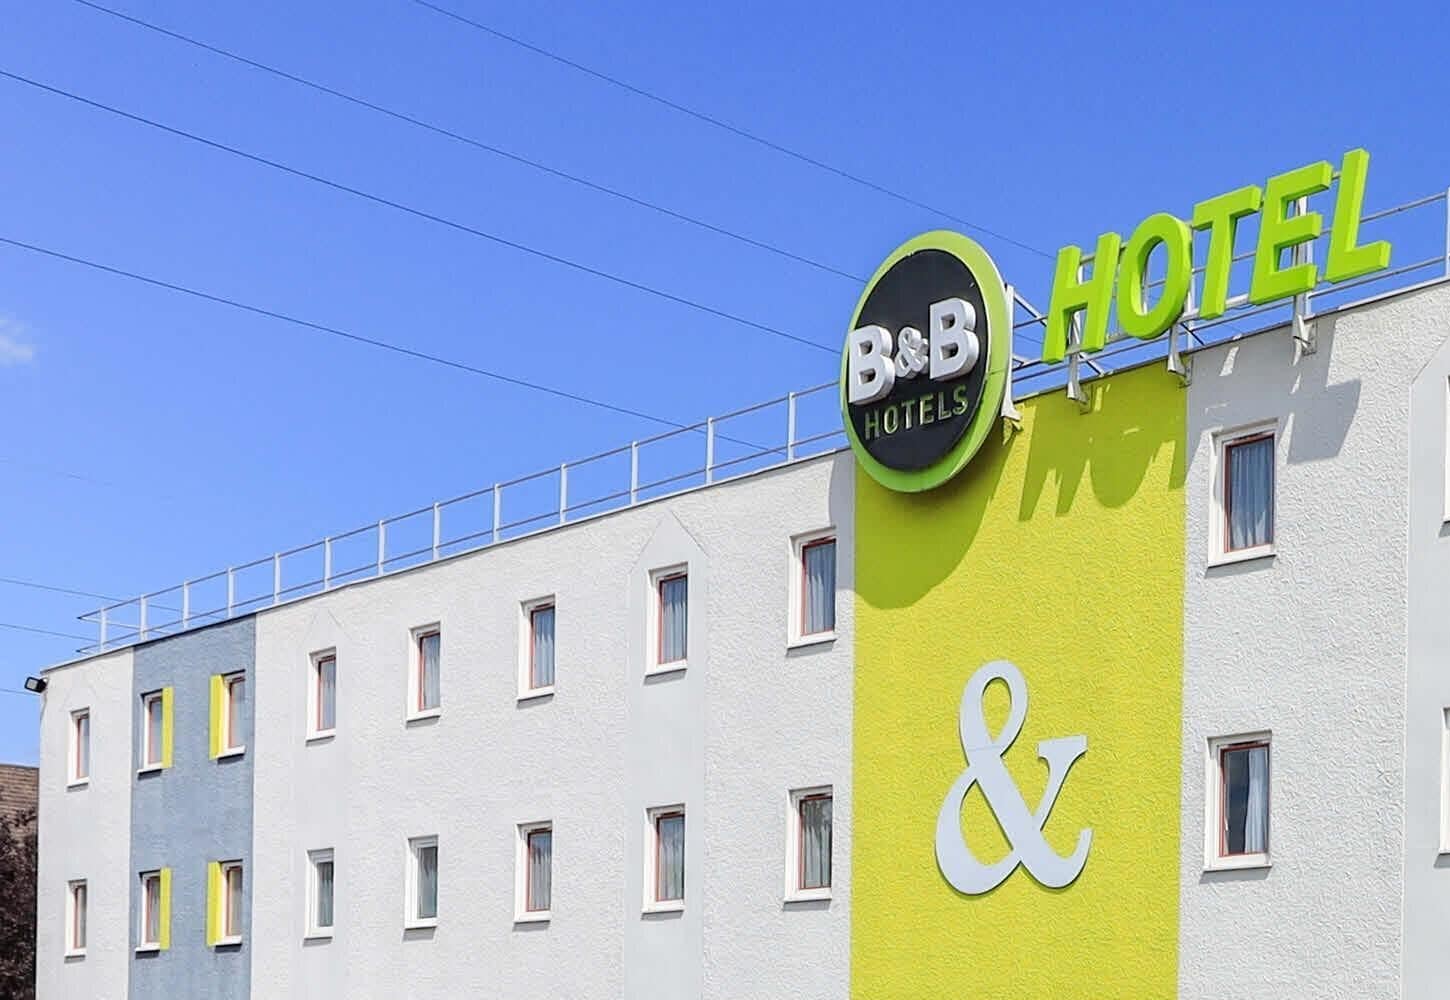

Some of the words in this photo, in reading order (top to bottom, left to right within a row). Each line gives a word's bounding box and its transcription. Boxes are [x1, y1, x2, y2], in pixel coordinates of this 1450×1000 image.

[1042, 147, 1391, 364] HOTEL
[848, 298, 979, 405] B&B
[864, 385, 969, 441] HOTELS
[935, 659, 1094, 896] &
